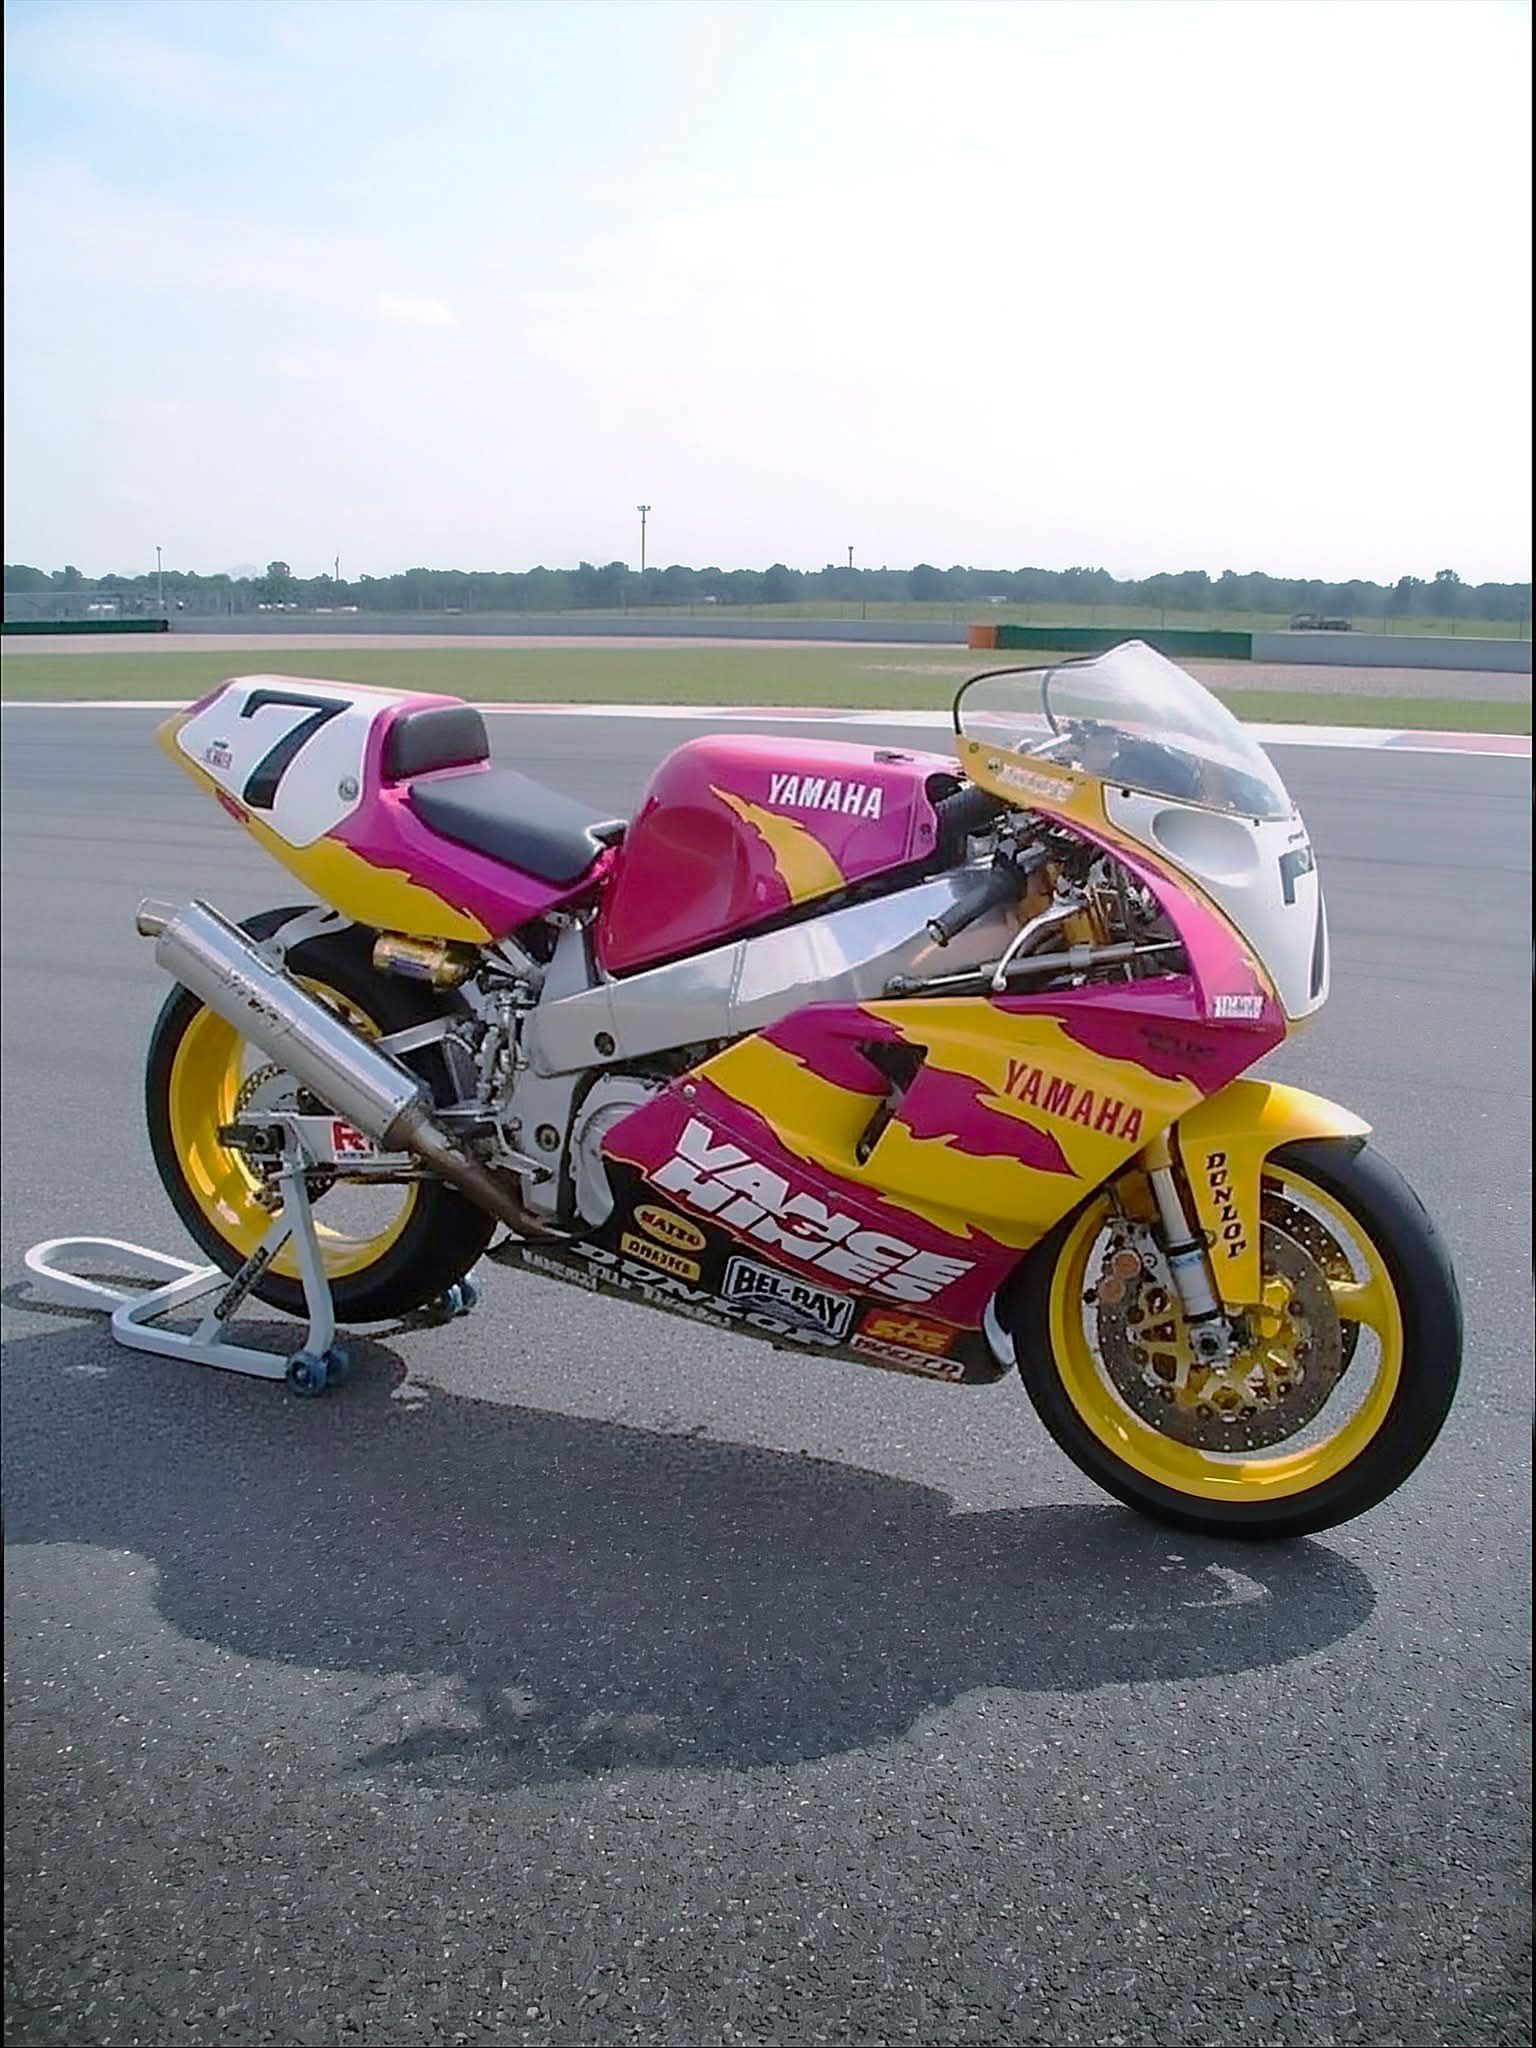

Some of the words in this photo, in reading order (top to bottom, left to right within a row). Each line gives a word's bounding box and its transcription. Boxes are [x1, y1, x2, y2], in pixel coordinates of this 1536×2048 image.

[241, 689, 353, 810] 7
[768, 774, 883, 819] YAMAHA
[1003, 1059, 1143, 1143] YAMAHA
[650, 1156, 943, 1303] HINES
[675, 1117, 977, 1285] VANCE
[1205, 1151, 1246, 1258] DUNLOP
[569, 1240, 840, 1347] DUNLOP
[732, 1264, 846, 1329] BEL-RAY
